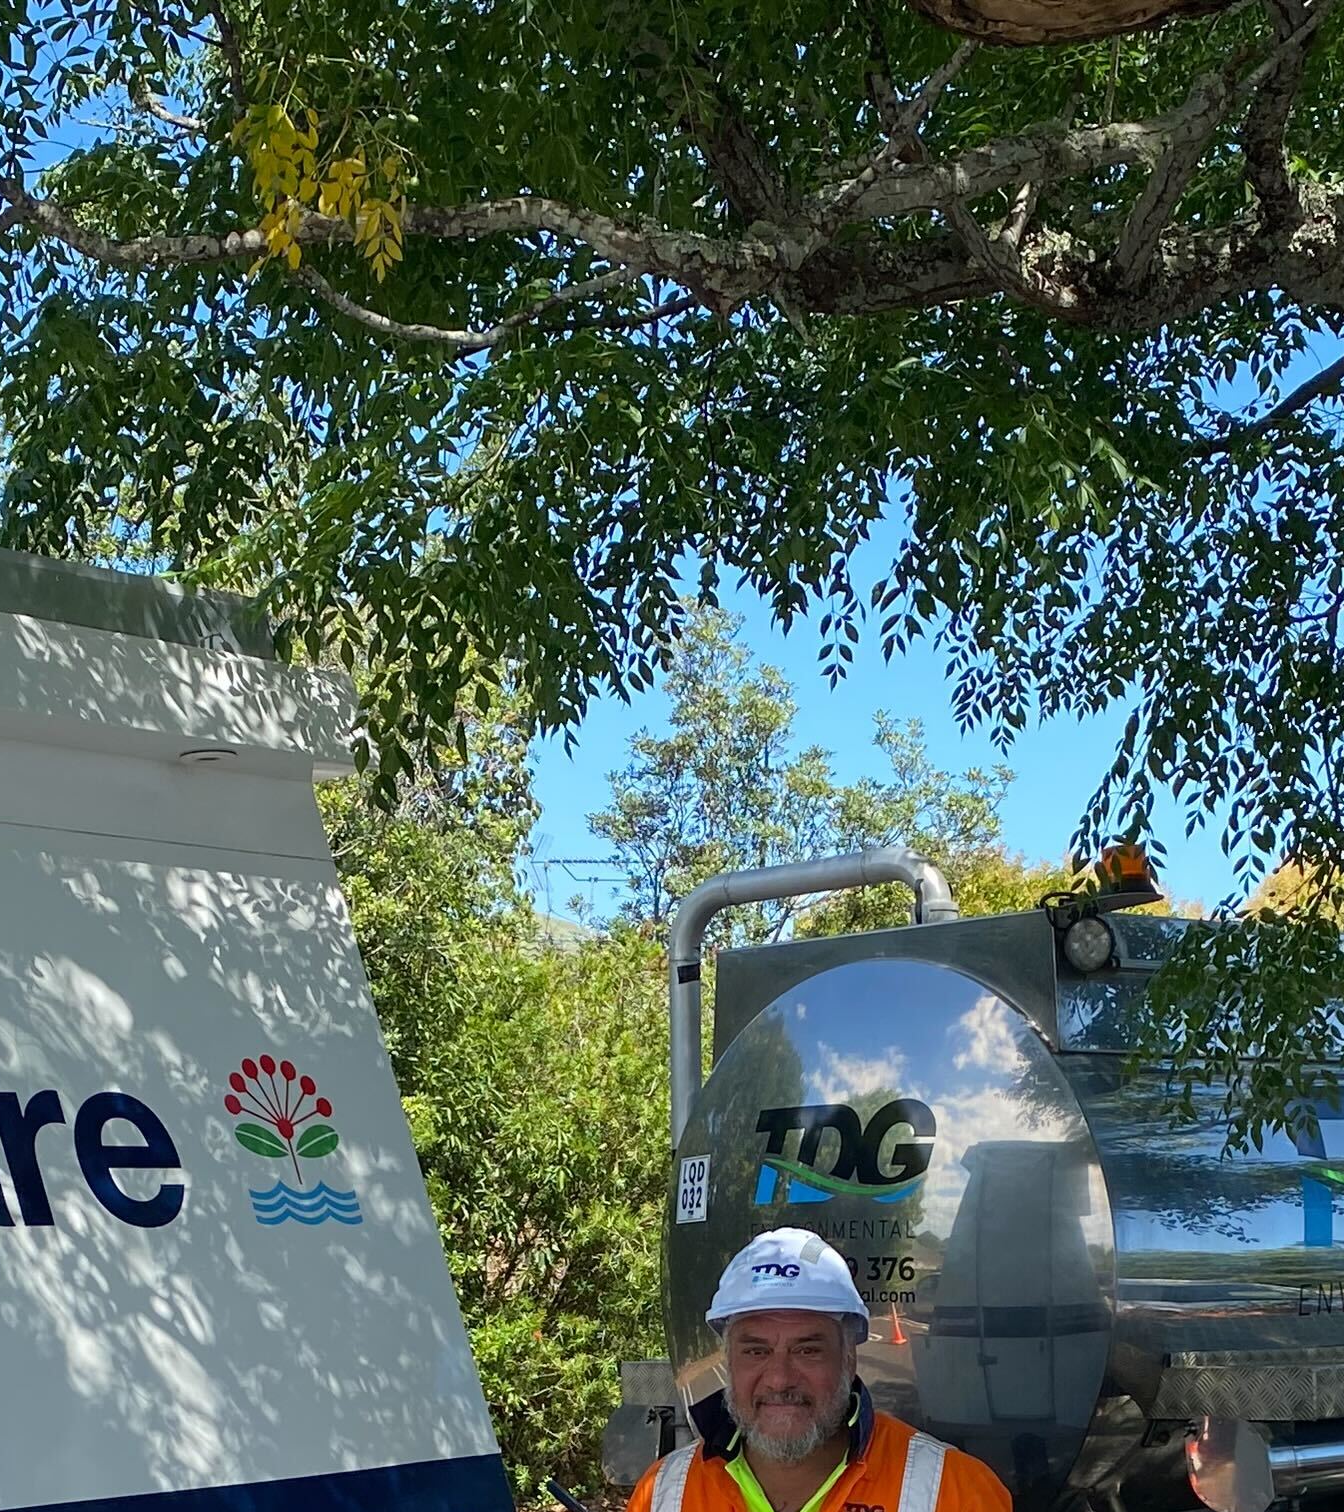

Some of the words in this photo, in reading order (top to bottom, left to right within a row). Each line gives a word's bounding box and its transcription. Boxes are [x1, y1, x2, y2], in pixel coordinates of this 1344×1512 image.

[756, 1098, 937, 1184] TDG
[681, 1186, 702, 1210] 032
[751, 1263, 801, 1279] TDG
[866, 1256, 916, 1281] 376
